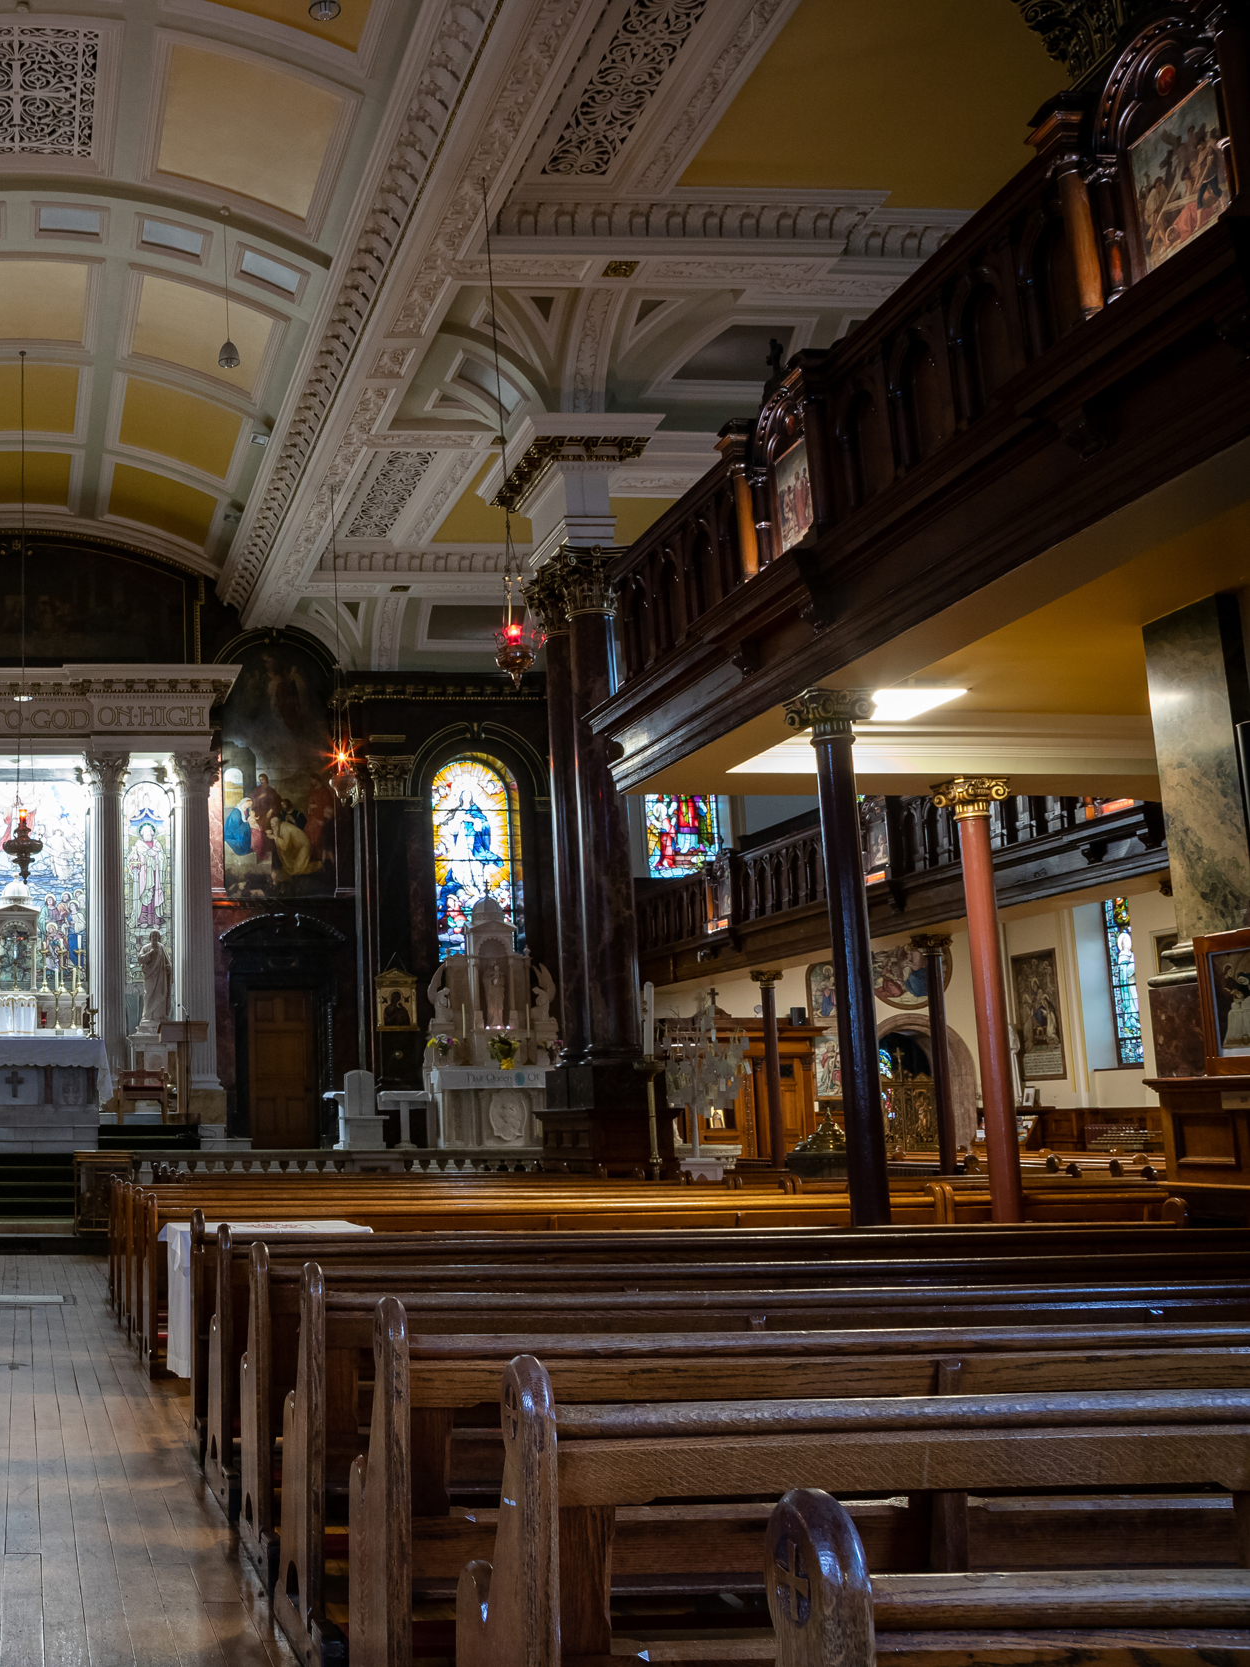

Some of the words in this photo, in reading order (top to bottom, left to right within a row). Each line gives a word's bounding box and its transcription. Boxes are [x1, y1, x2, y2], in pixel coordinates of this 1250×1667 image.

[30, 708, 91, 730] GOD
[137, 705, 207, 727] HIGH
[486, 1073, 513, 1083] Queen
